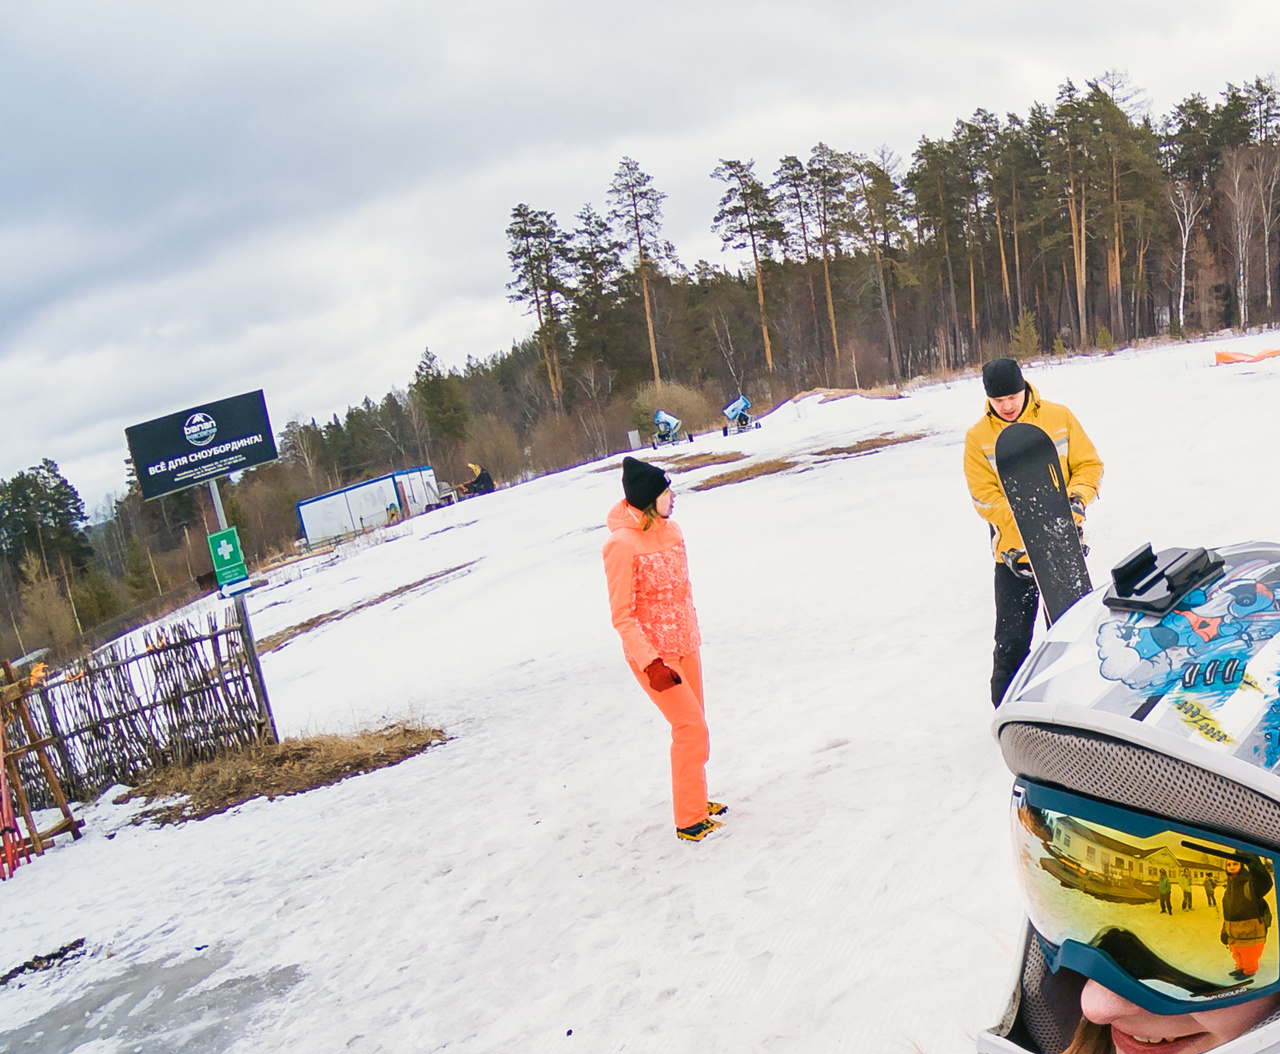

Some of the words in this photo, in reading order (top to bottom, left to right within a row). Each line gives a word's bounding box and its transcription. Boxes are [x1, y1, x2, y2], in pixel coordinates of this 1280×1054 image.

[184, 420, 217, 435] banan
[148, 461, 167, 476] ВСЁ
[168, 457, 189, 471] ДЛЯ
[188, 433, 263, 463] СНОУБОРДИНГА!
